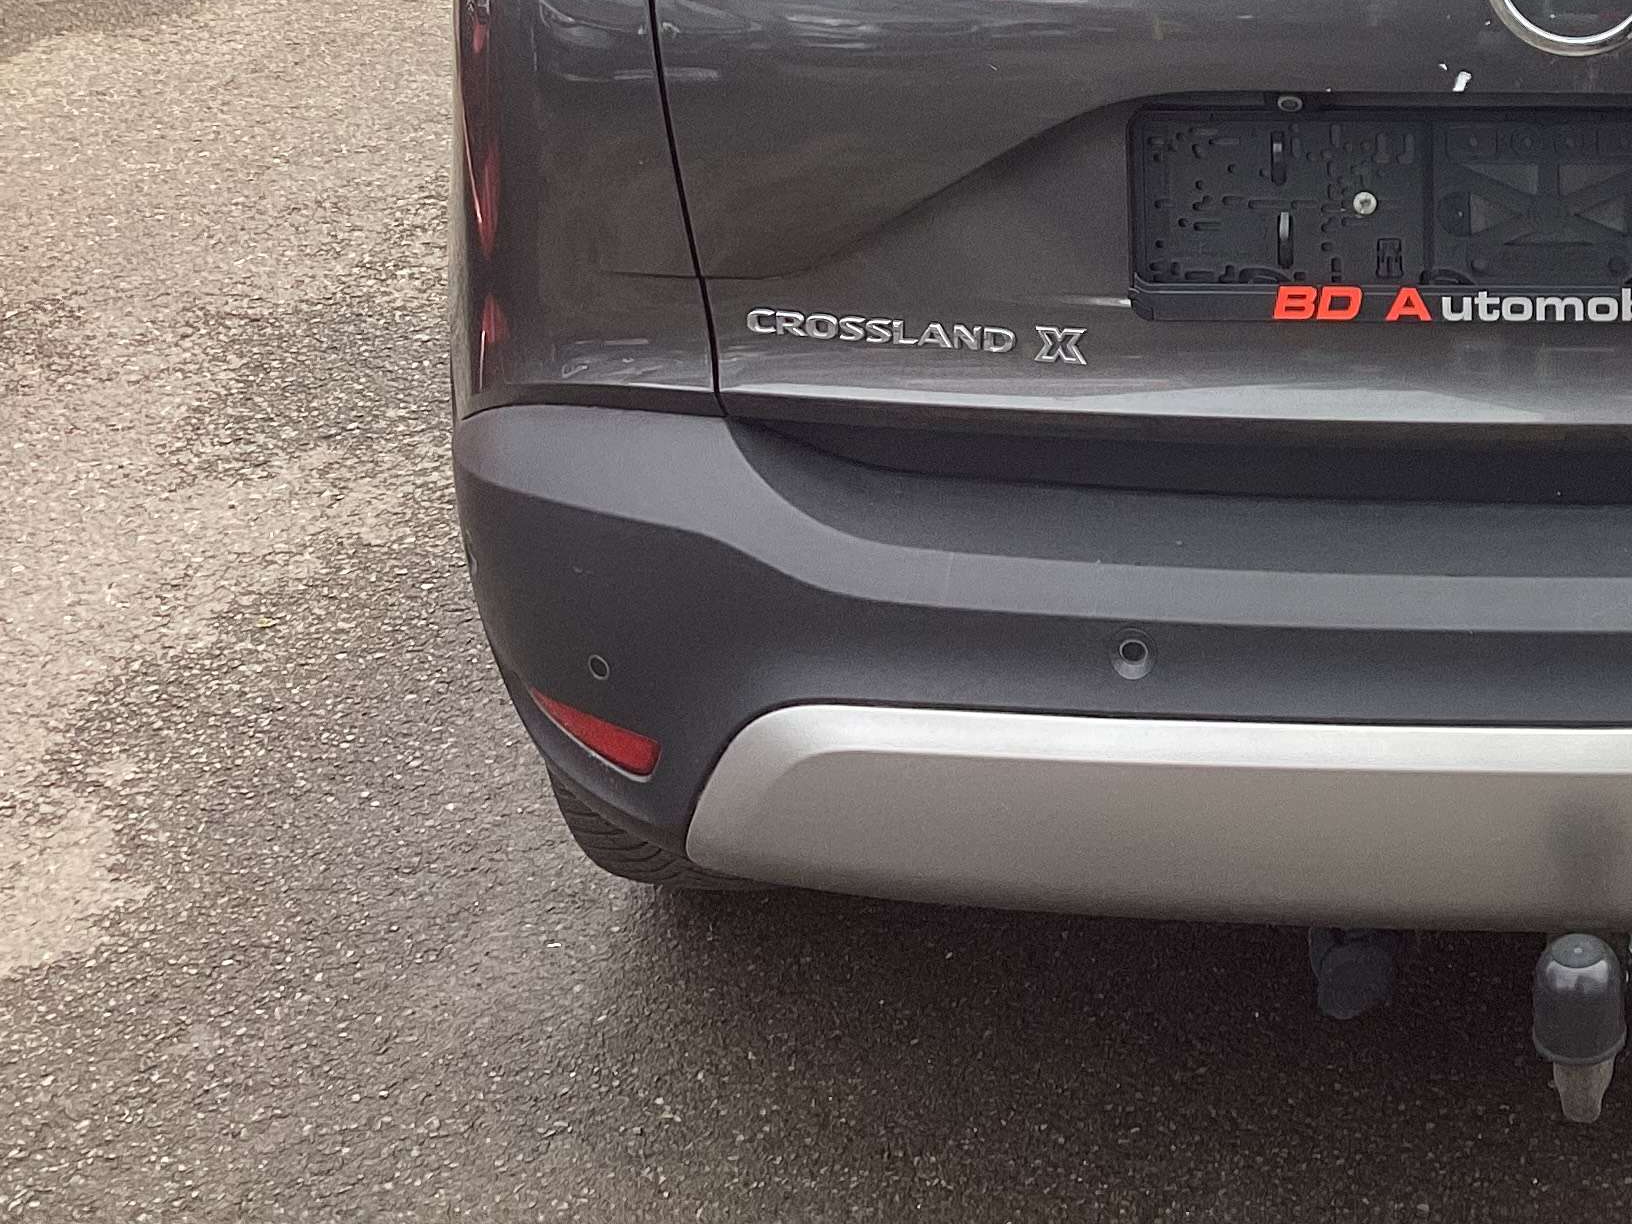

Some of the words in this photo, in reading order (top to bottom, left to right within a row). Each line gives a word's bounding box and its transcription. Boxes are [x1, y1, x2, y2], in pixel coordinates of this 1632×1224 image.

[1273, 285, 1364, 321] BD
[746, 307, 1017, 354] CROSSLAND
[1034, 325, 1088, 365] X
